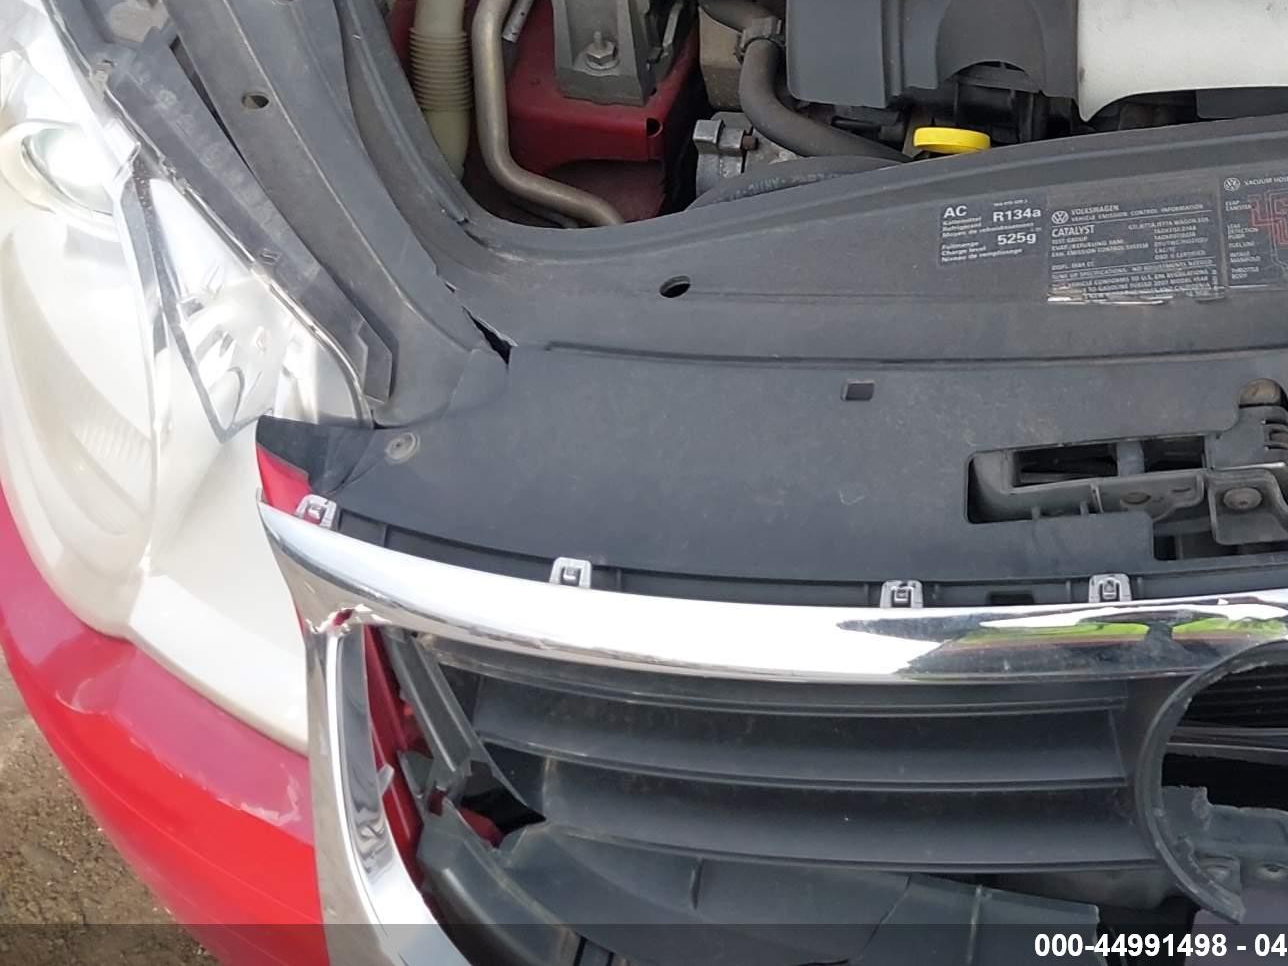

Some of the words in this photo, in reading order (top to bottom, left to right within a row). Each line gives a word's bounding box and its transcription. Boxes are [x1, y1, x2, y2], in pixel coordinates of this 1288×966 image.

[1244, 177, 1272, 185] VACUUM
[943, 205, 968, 218] AC
[992, 208, 1042, 222] R134a
[1071, 205, 1119, 215] VOLKSWAGEN
[1098, 212, 1128, 220] EMISSION
[1161, 204, 1204, 213] INFORMATION
[1052, 224, 1095, 237] CATALYST
[997, 232, 1037, 245] 525g
